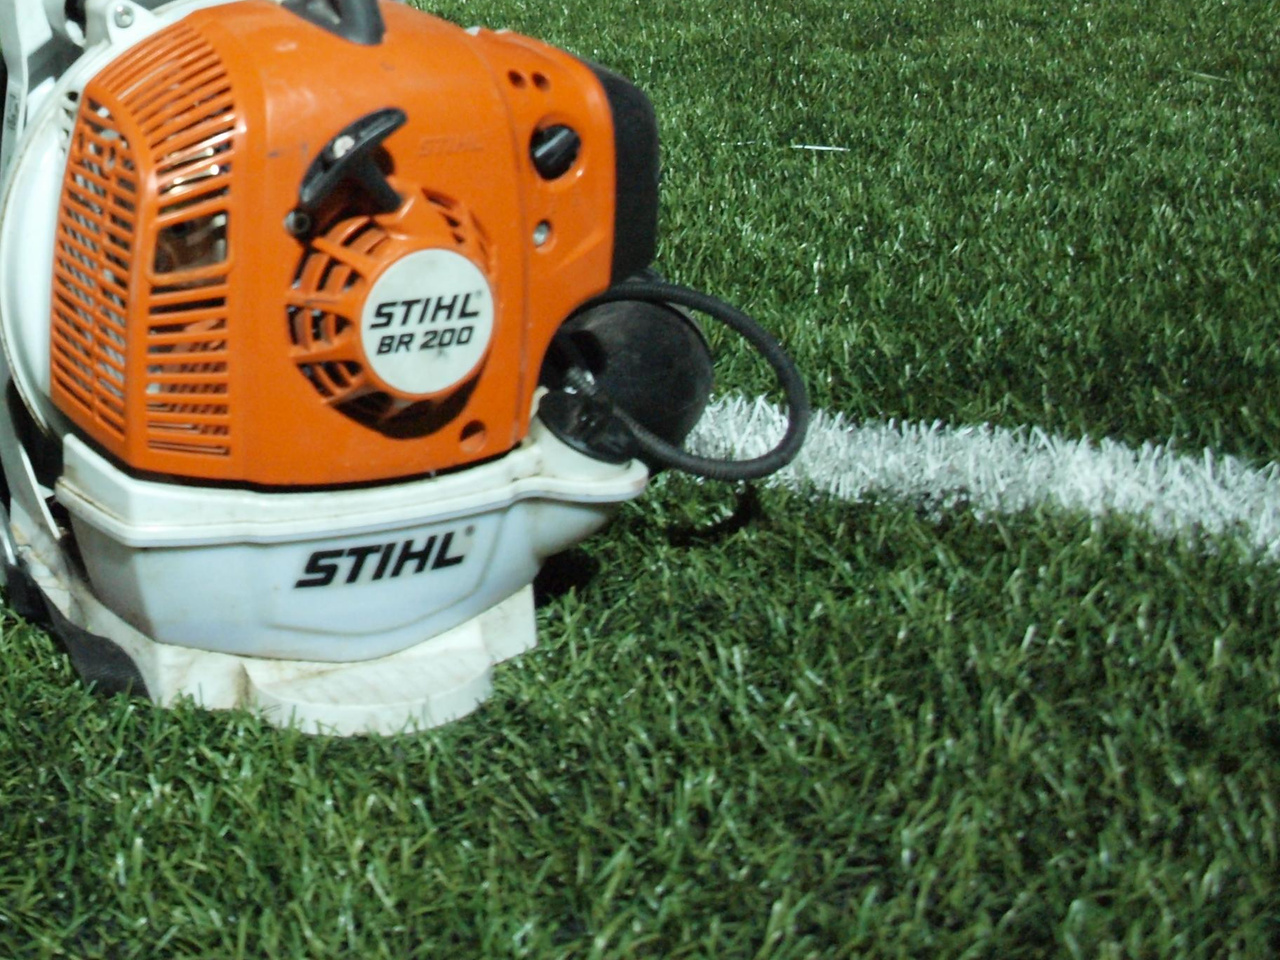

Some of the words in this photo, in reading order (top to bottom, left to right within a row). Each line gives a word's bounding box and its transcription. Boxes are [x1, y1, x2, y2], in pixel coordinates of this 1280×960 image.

[370, 293, 479, 330] STIHL
[377, 333, 415, 356] BR
[420, 326, 474, 351] 200
[295, 532, 464, 588] STIHL
